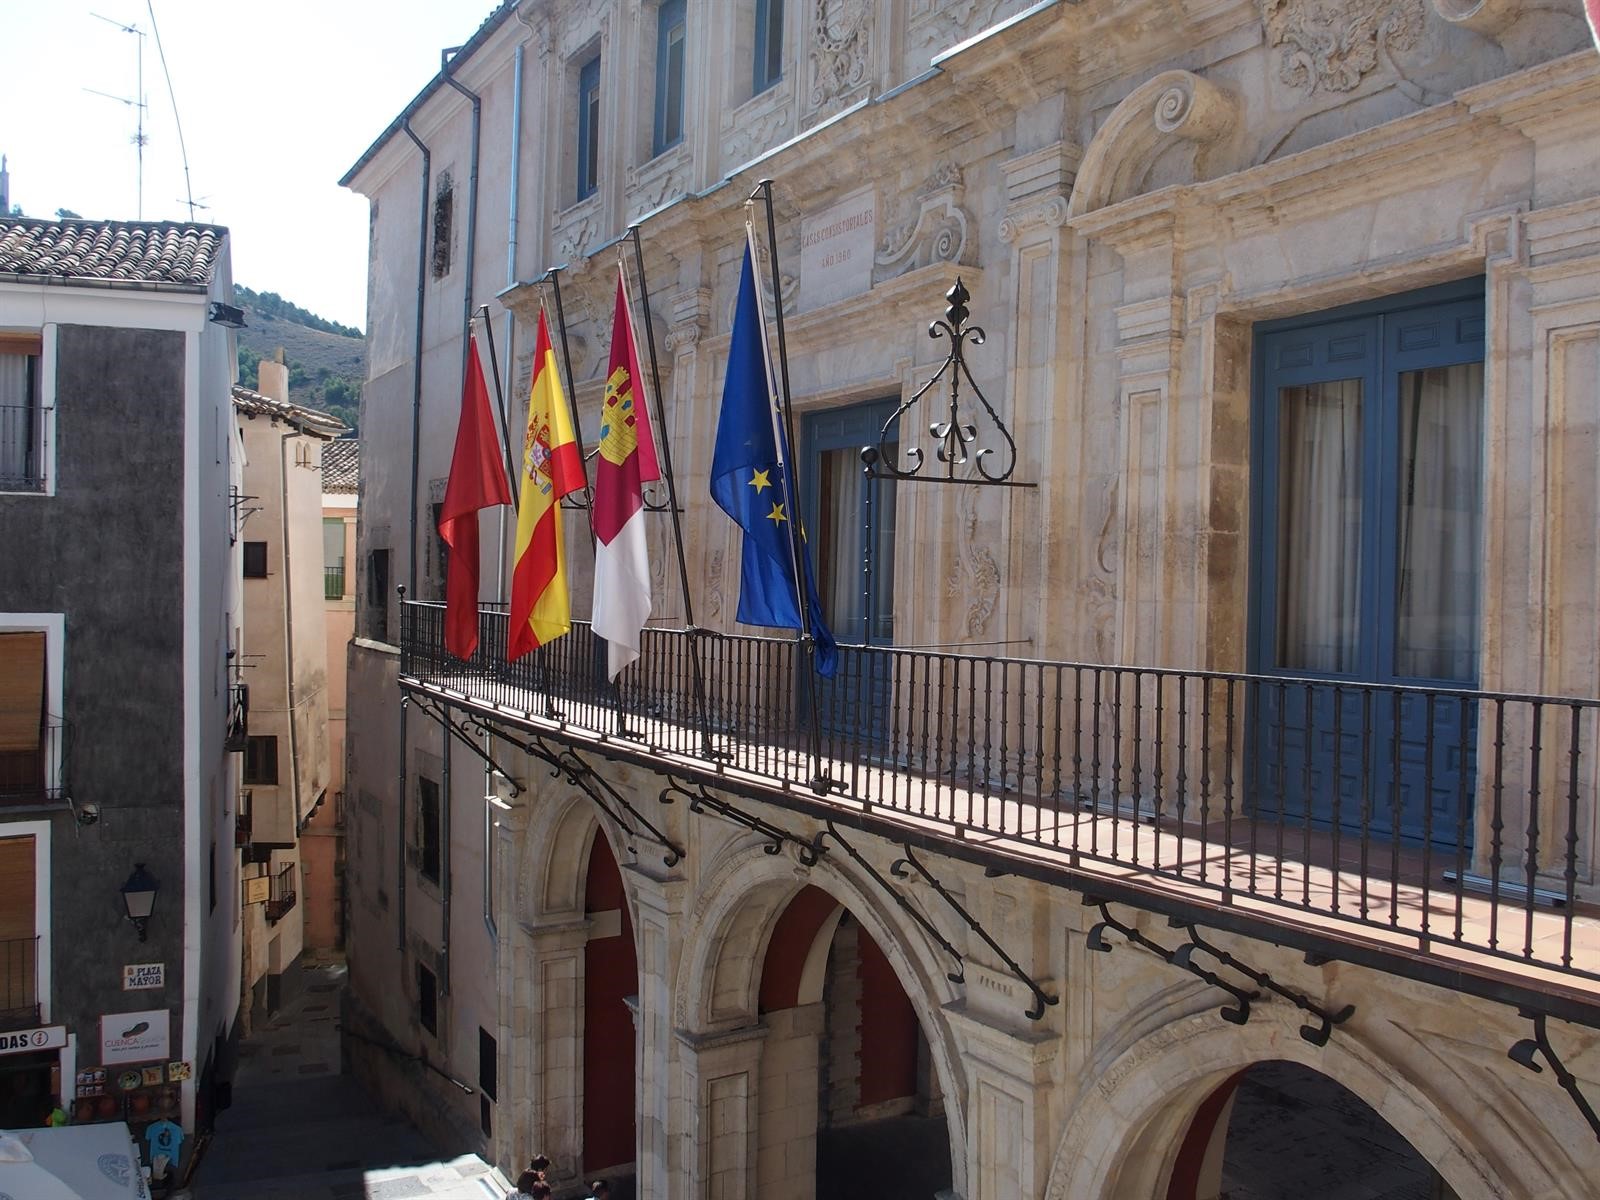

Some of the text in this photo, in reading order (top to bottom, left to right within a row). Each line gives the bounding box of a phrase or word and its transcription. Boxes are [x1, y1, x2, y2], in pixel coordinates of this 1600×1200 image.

[137, 966, 161, 977] PLAZA
[129, 975, 161, 986] MAYOR
[105, 1038, 139, 1048] CUENCA
